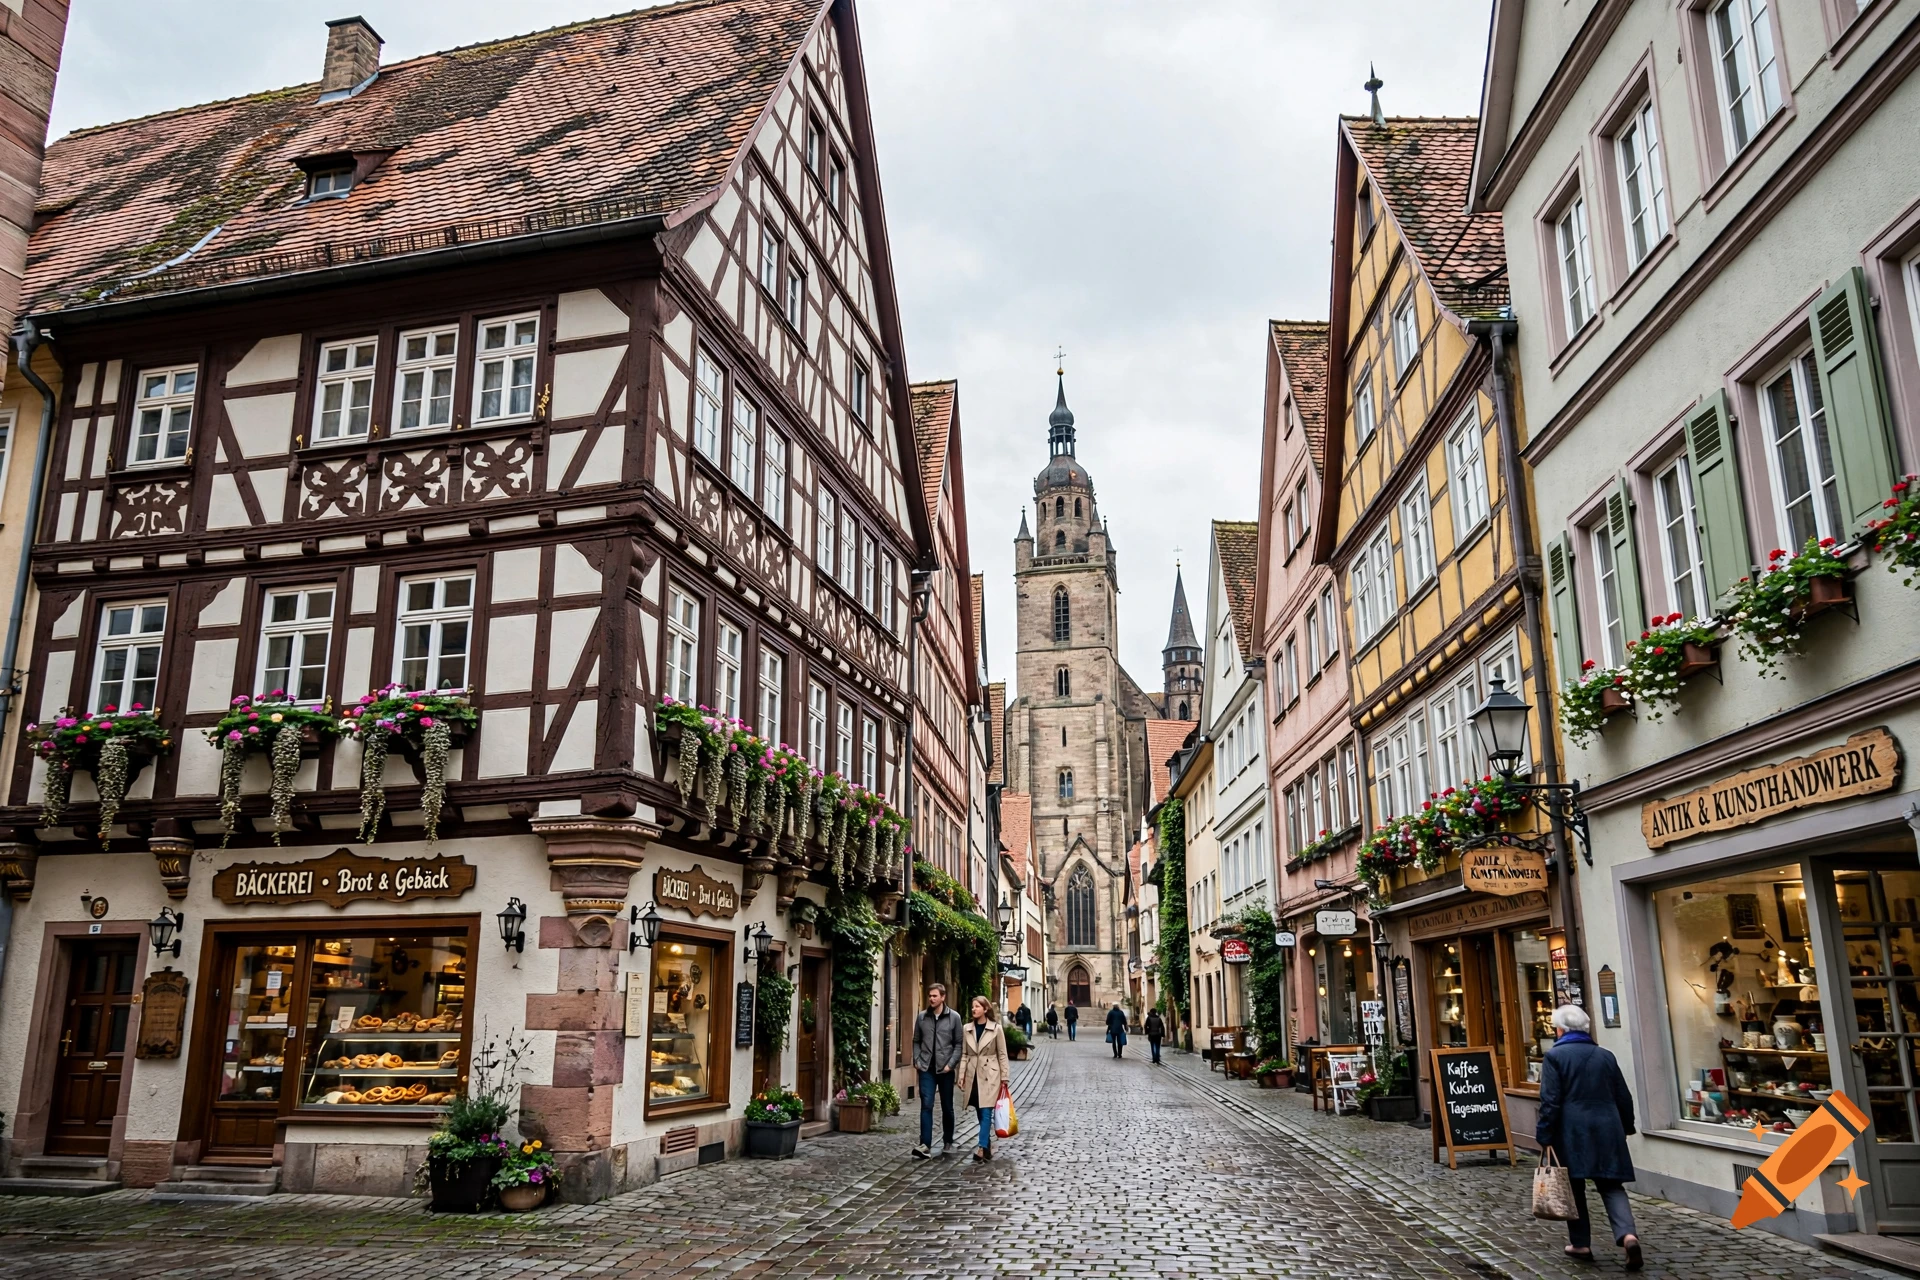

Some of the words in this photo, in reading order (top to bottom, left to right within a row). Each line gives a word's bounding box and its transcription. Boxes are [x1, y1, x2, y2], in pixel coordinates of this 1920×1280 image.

[1652, 801, 1694, 838] ANTIK
[1698, 796, 1711, 826] &
[1712, 744, 1881, 821] KUNSTHANDWERK
[235, 870, 313, 896] BÄCKEREI
[336, 869, 373, 894] Brot
[378, 872, 389, 890] &
[395, 866, 449, 897] Gebäck
[1447, 1061, 1479, 1078] Kaffee
[1449, 1080, 1485, 1095] Kuchen
[1447, 1100, 1498, 1118] Tagesmenü
